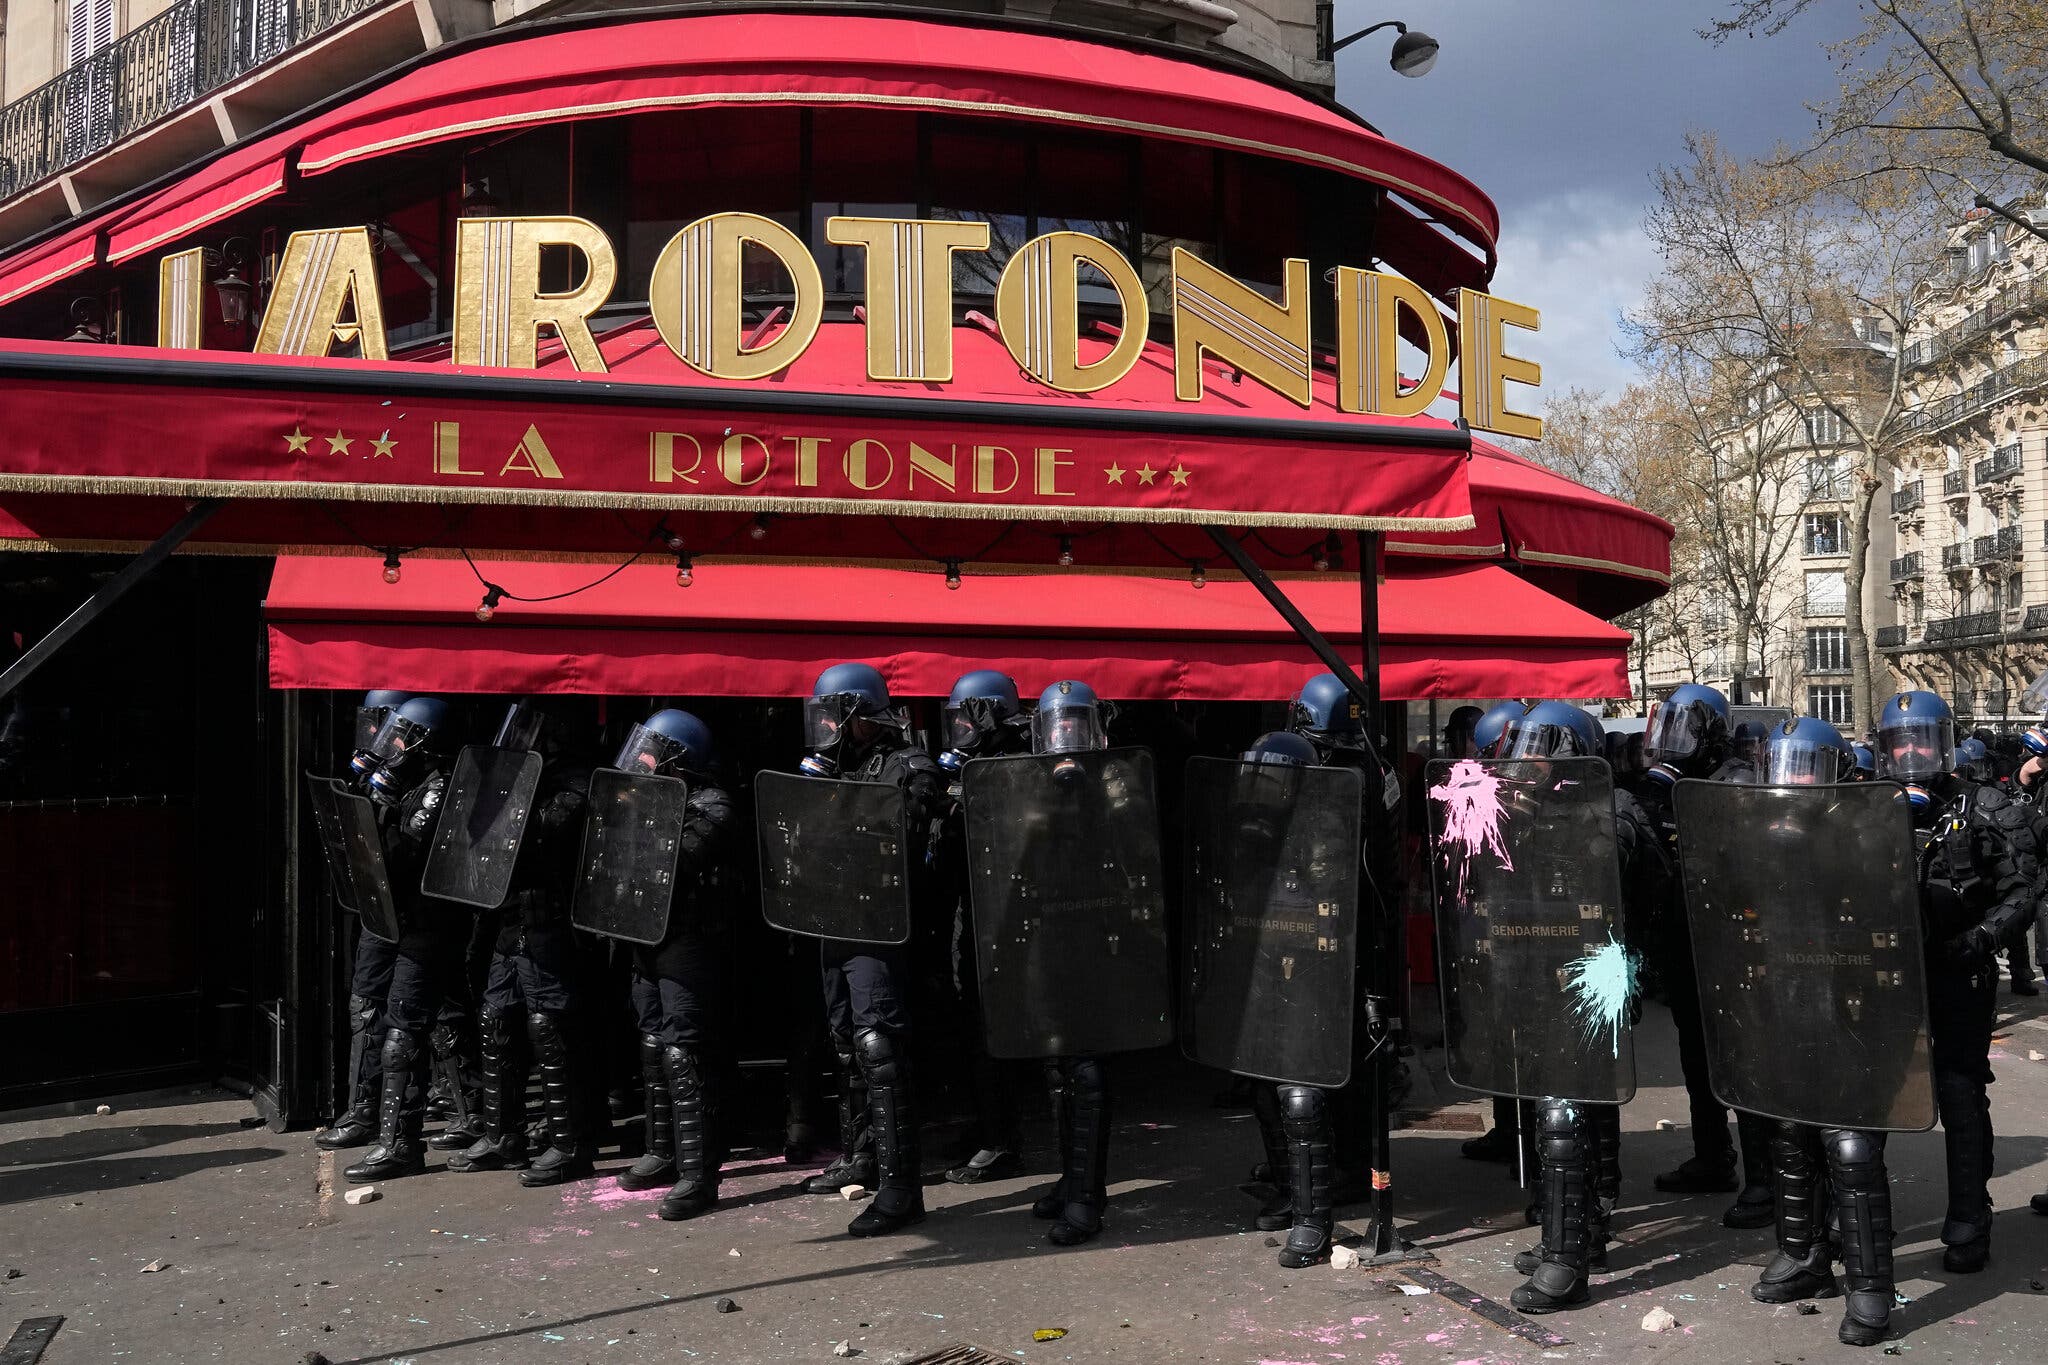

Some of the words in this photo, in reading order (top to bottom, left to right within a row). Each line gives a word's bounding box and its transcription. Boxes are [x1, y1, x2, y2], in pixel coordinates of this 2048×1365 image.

[455, 211, 1543, 440] ROTONDE
[433, 421, 564, 479] LA
[649, 431, 1075, 496] ROTONDE
[1233, 914, 1317, 934] GENDARMERIE
[1490, 924, 1581, 937] GENDARMERIE
[1775, 950, 1873, 967] NDARMERIE
